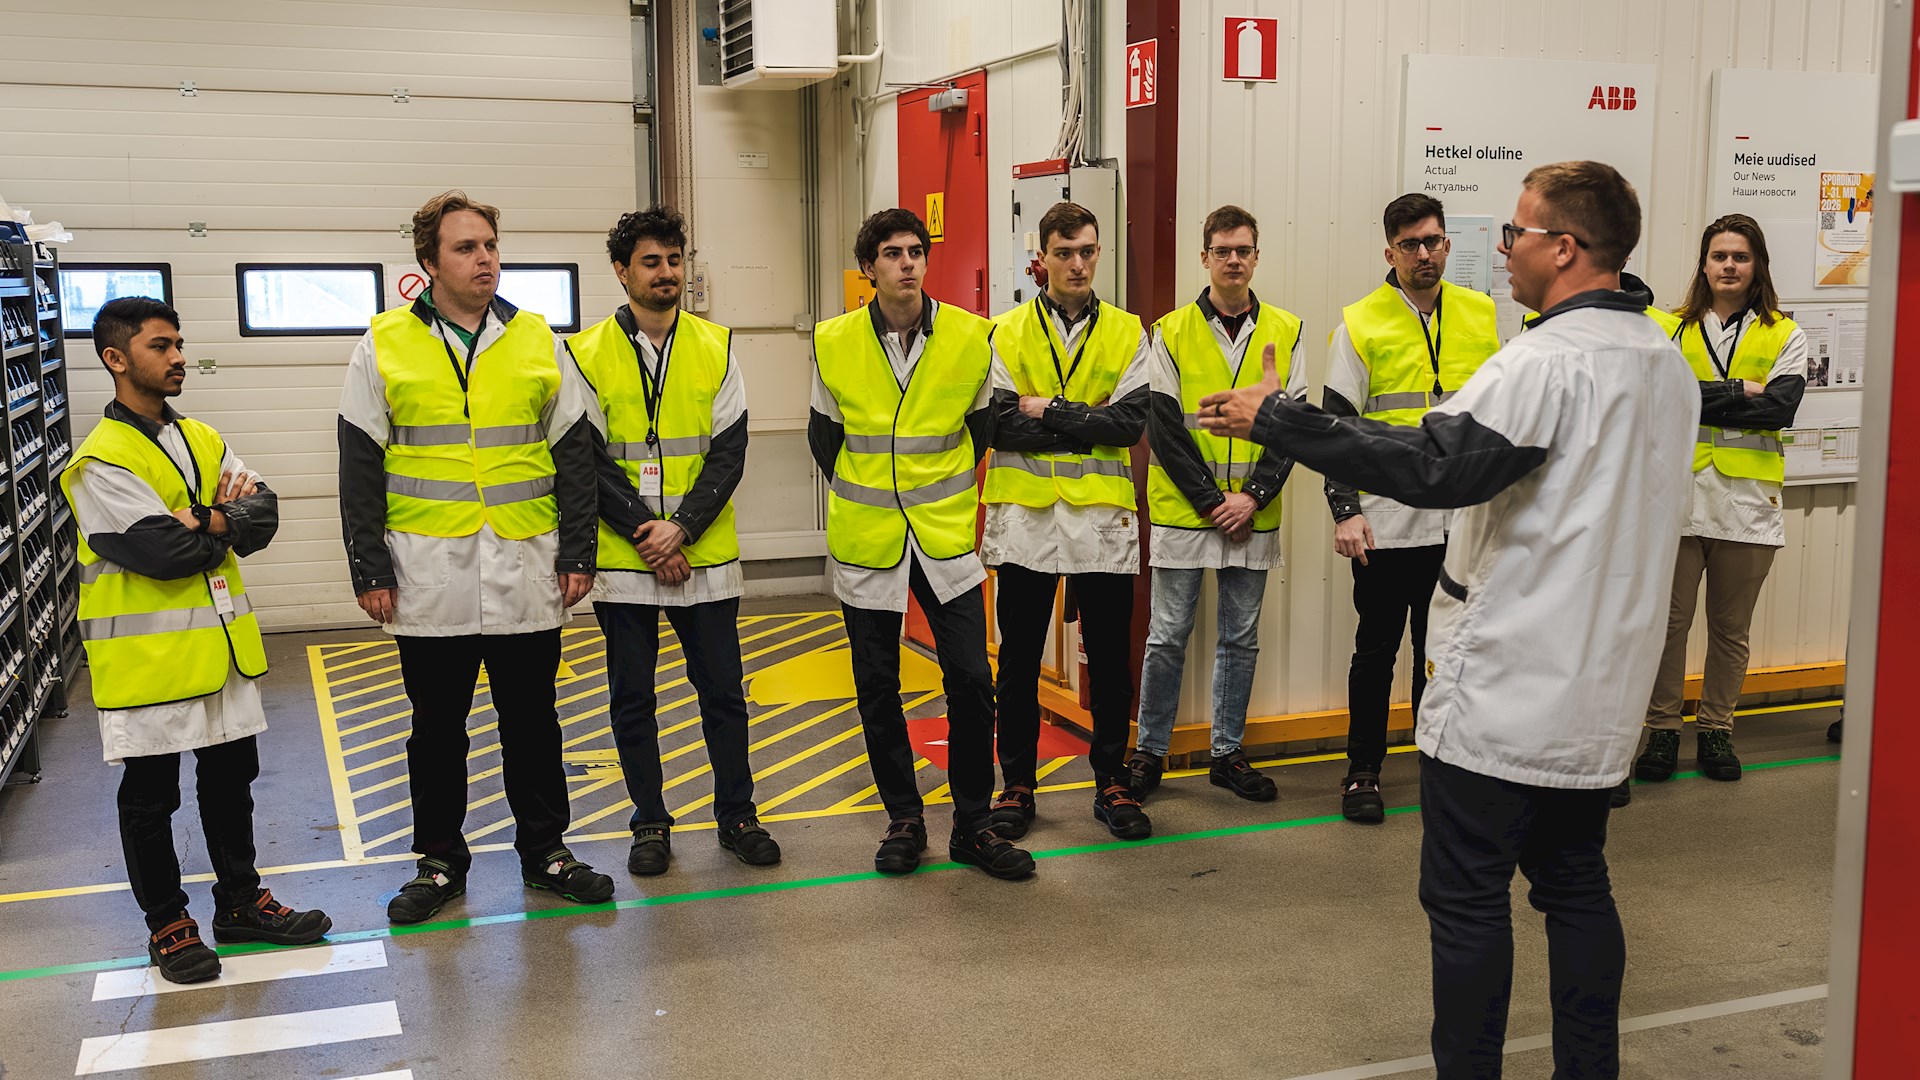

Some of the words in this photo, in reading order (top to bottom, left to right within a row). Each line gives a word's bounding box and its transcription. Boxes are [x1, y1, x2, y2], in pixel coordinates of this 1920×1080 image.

[1588, 86, 1637, 111] ABB
[1425, 145, 1472, 159] Hetkel
[1476, 146, 1523, 160] oluline
[1734, 153, 1764, 165] Meie
[1767, 154, 1816, 166] uudised
[1424, 165, 1457, 175] Actual
[1733, 171, 1749, 181] Our
[1752, 172, 1776, 181] News
[1821, 174, 1860, 186] SPORDIKUU
[1424, 182, 1479, 193] Актуально
[1732, 187, 1758, 196] Наши
[1760, 189, 1796, 197] новости
[1821, 199, 1841, 211] 2026
[643, 466, 658, 475] ABB
[213, 580, 226, 590] ABB
